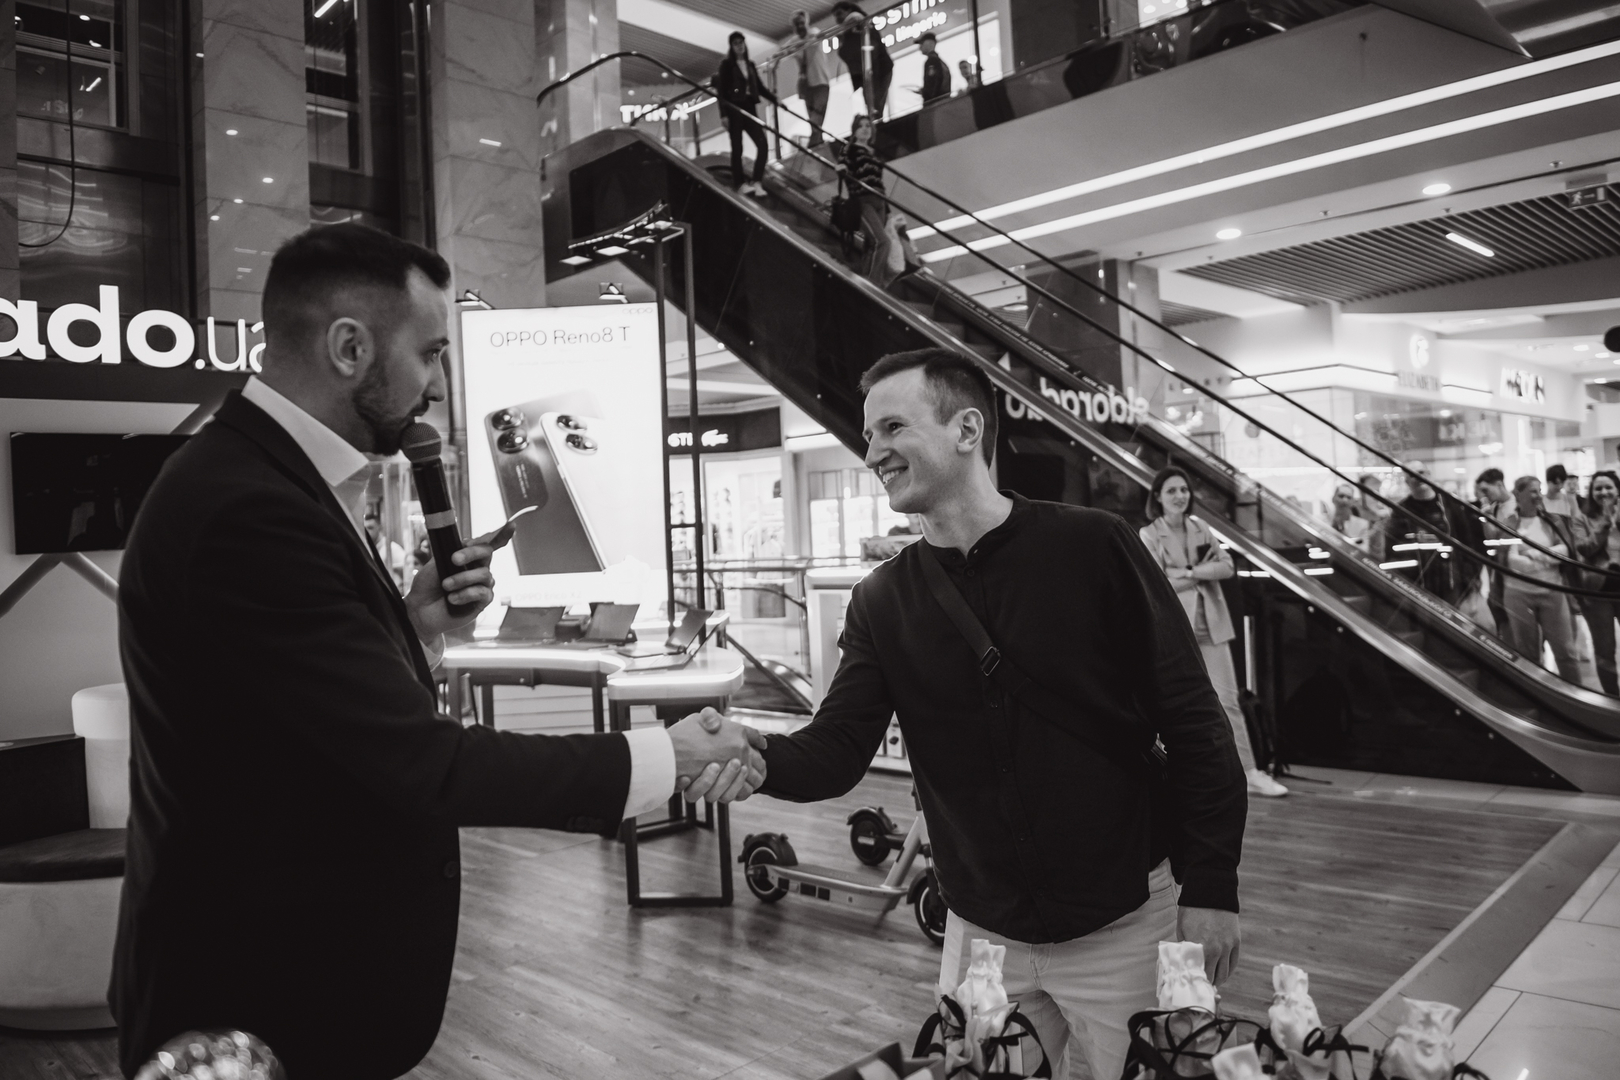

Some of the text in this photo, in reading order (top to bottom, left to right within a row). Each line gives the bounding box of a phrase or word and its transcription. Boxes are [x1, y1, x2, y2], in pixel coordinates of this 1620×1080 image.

[489, 325, 631, 348] OPPO Reno8 T
